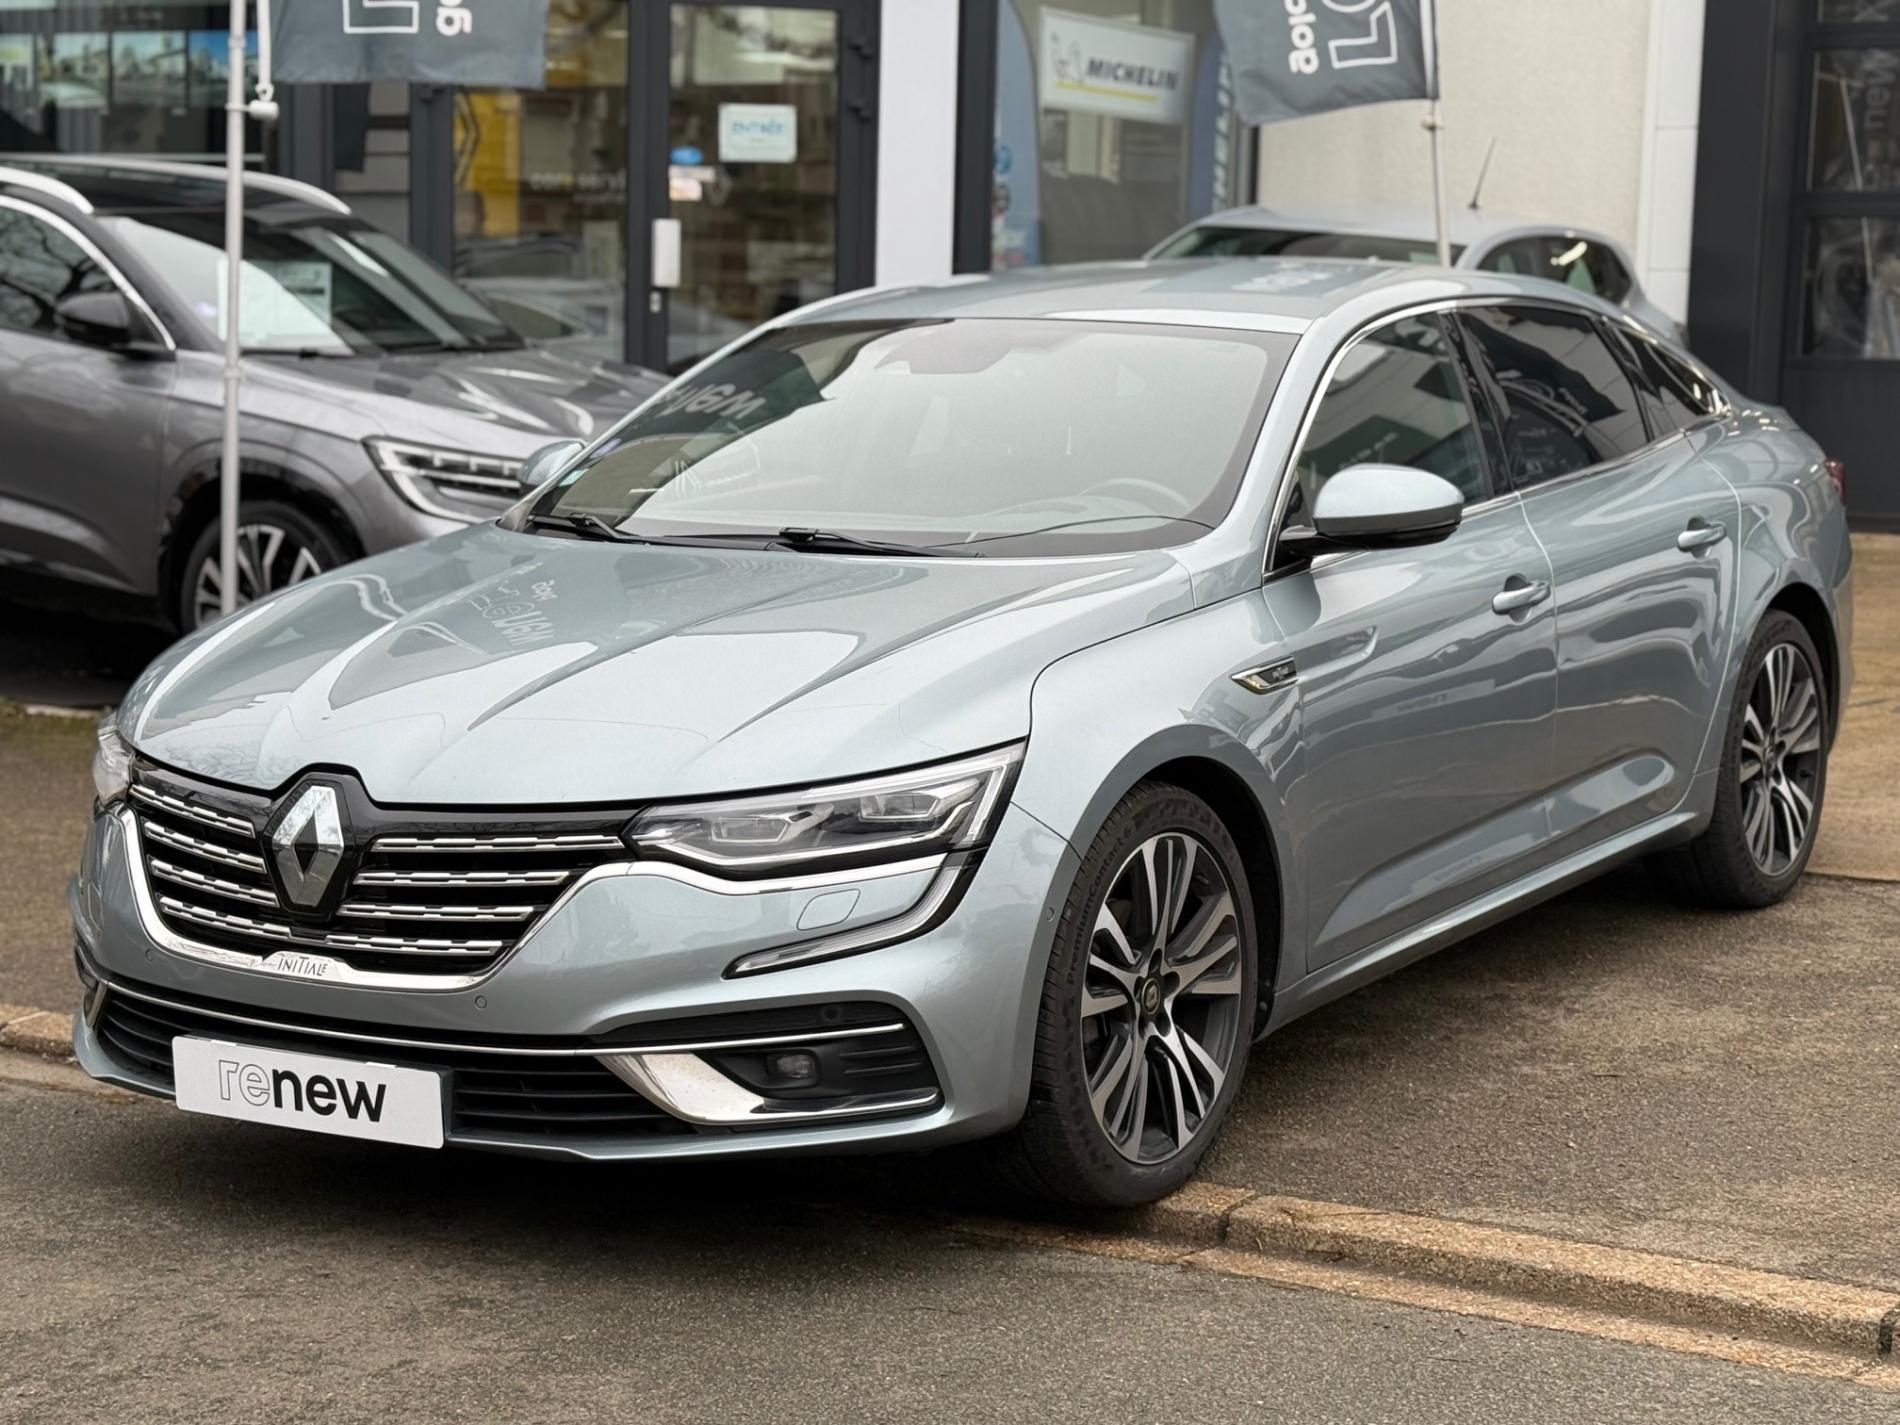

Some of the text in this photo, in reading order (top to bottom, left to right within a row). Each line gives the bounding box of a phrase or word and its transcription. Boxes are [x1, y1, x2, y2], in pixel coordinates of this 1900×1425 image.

[1087, 57, 1179, 90] MICHELIN
[277, 956, 328, 976] INITIALE
[218, 1059, 387, 1123] renew
